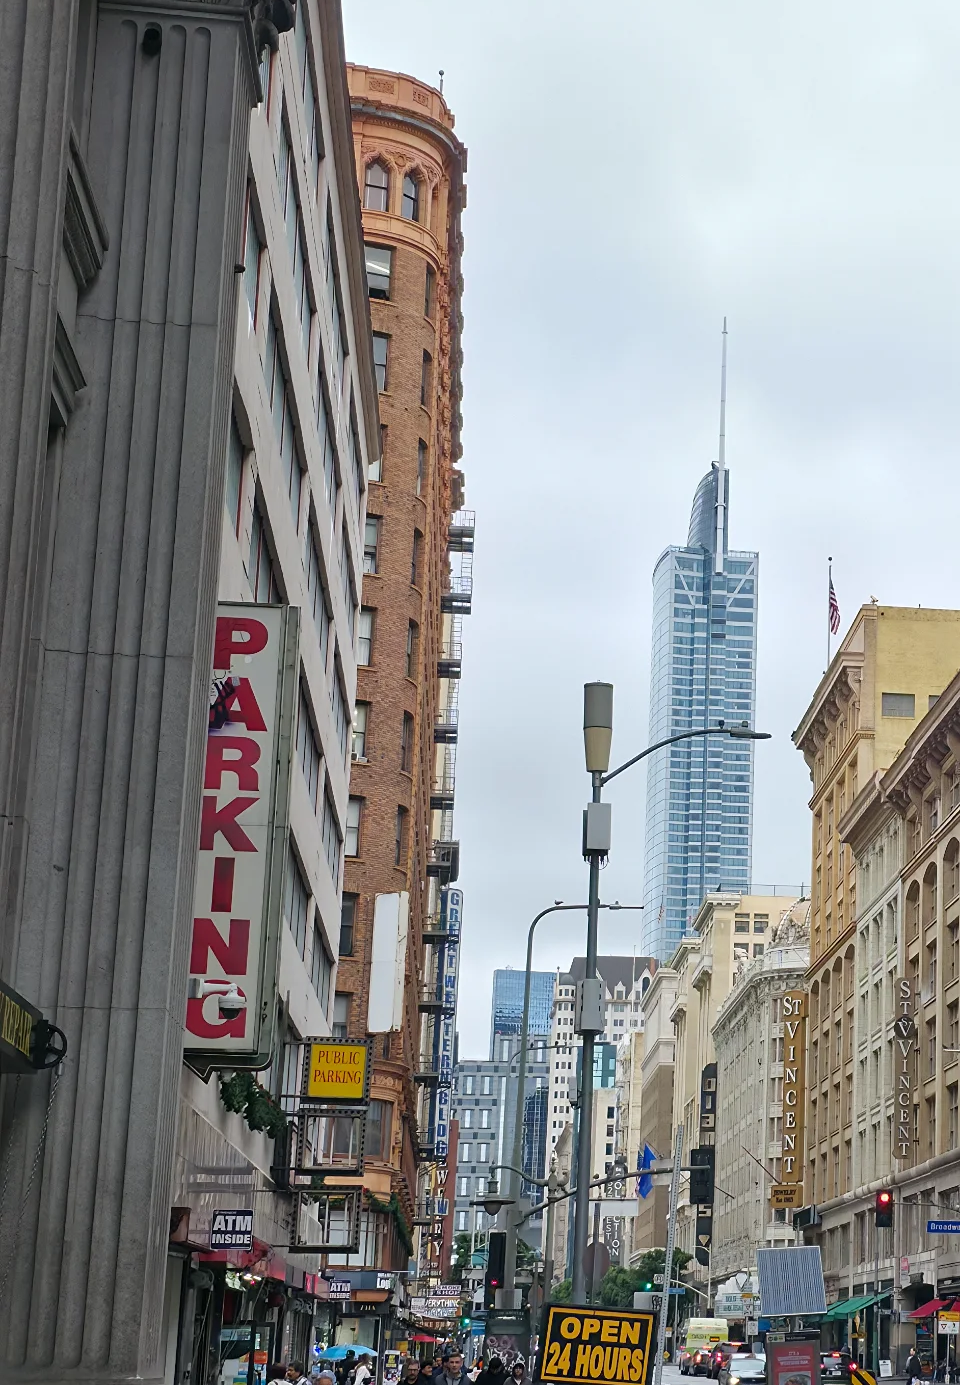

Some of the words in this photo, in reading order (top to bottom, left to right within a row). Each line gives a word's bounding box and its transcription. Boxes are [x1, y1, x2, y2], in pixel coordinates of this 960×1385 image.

[185, 617, 268, 1039] PARKING
[783, 996, 801, 1015] ST
[2, 995, 33, 1057] REPAIR
[318, 1051, 360, 1064] PUBLIC
[313, 1070, 361, 1084] PARKING
[783, 1021, 799, 1173] VINCENT
[898, 1040, 913, 1156] VINCENT
[213, 1215, 252, 1231] ATM
[212, 1234, 250, 1244] INSIDE
[331, 1282, 350, 1291] ATM
[560, 1317, 641, 1344] OPEN
[546, 1342, 571, 1375] 24
[575, 1345, 644, 1382] HOURS
